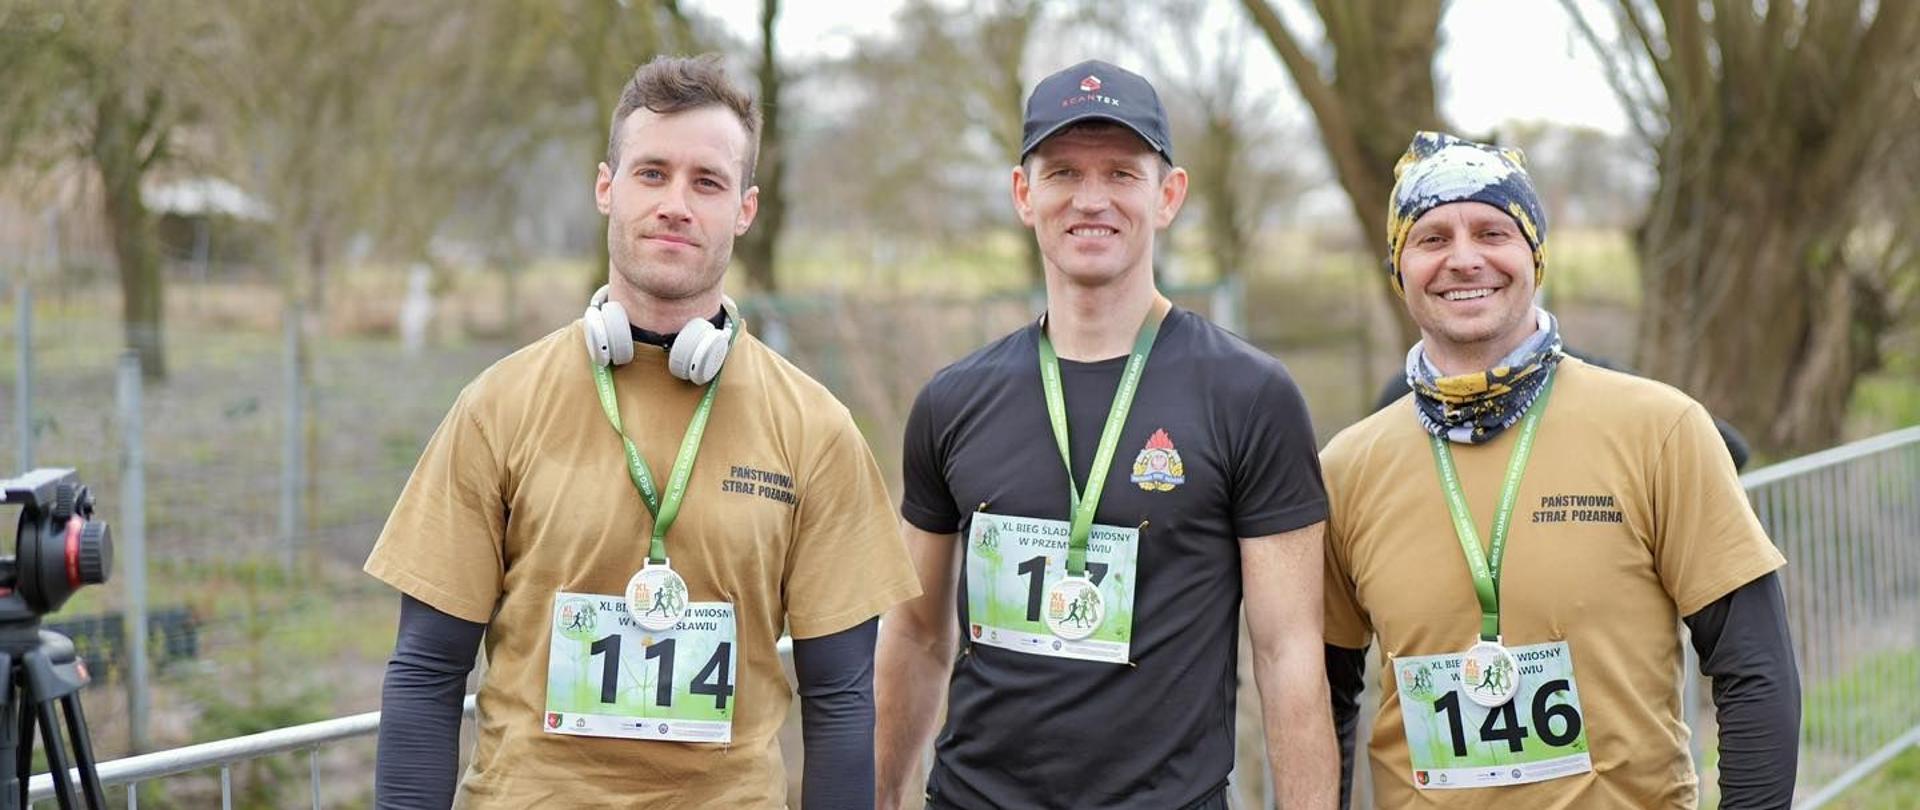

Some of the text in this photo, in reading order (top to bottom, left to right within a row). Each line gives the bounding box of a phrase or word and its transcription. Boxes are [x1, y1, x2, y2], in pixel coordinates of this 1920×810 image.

[1541, 493, 1614, 508] PAŃSTWOWA
[1002, 521, 1014, 531] XL
[1017, 523, 1039, 534] BIEG
[1091, 531, 1130, 542] WIOSNY
[1019, 537, 1030, 546] W
[600, 601, 613, 611] XL
[694, 608, 730, 619] WIOSN
[619, 617, 630, 626] W
[1432, 647, 1561, 670] XL BIE WIOSNY
[591, 634, 733, 709] 114
[1434, 679, 1582, 758] 146
